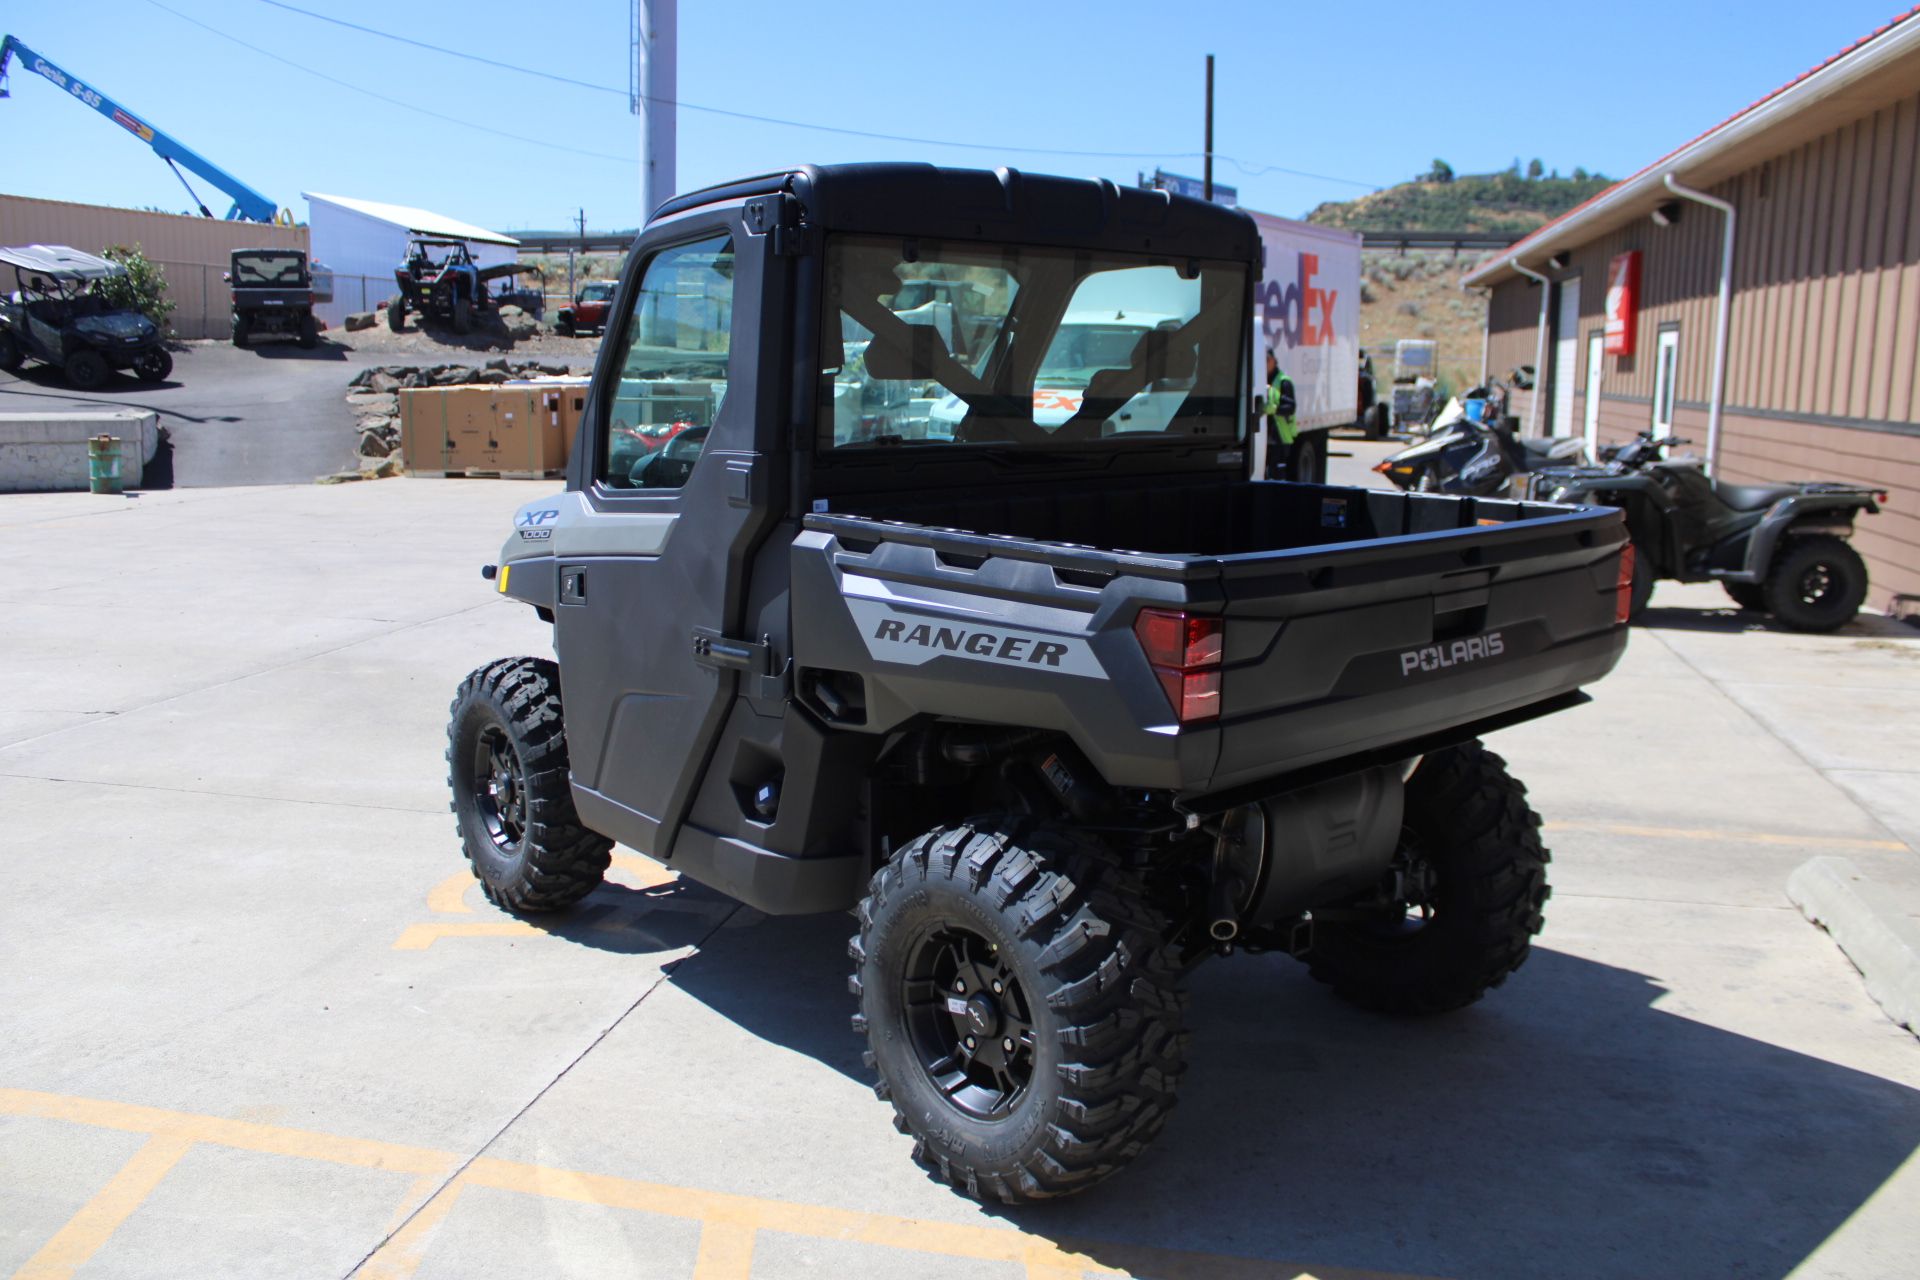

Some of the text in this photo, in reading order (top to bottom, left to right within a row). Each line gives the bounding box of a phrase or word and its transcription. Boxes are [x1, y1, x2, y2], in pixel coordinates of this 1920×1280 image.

[34, 58, 102, 108] Genie S-85
[1254, 246, 1338, 349] edEx
[519, 509, 559, 526] XP
[522, 529, 551, 539] 1000
[874, 618, 1069, 667] RANGER
[1400, 631, 1504, 676] POLARIS
